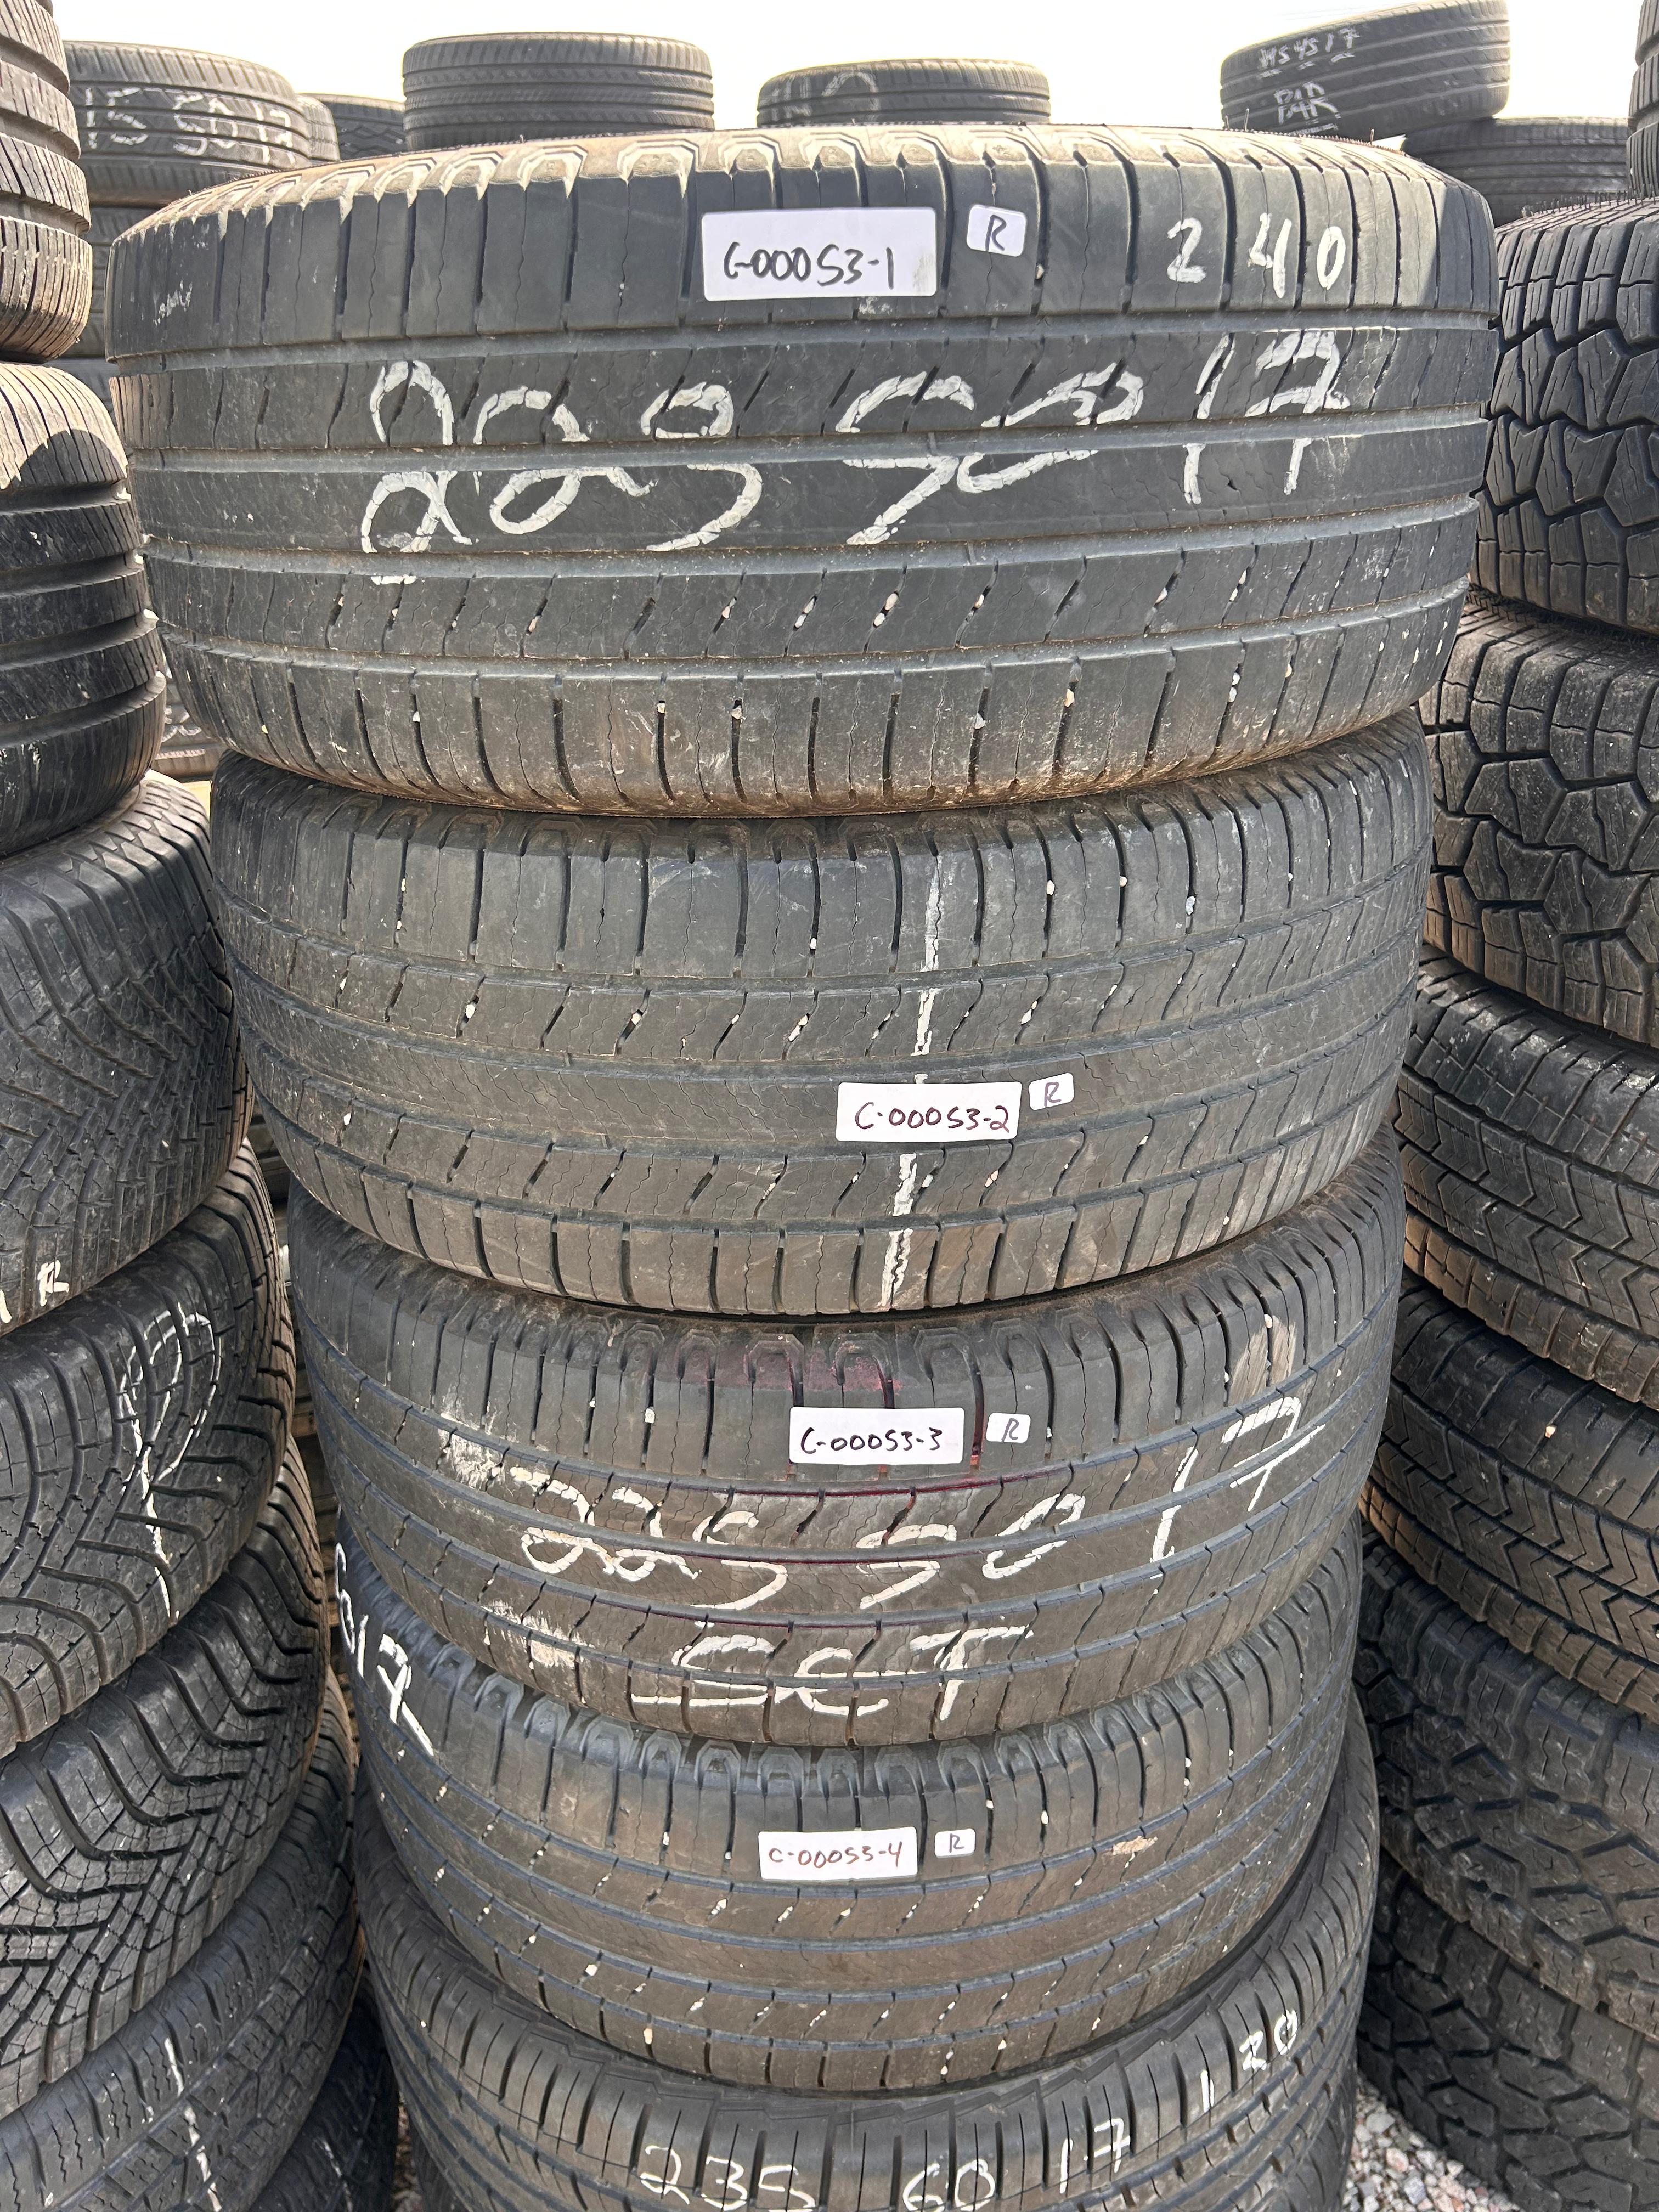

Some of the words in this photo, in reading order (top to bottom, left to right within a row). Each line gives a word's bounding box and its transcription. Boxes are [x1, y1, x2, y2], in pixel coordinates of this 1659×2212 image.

[984, 214, 1007, 254] R
[1167, 212, 1346, 298] 240
[1183, 329, 1351, 504] 17
[1044, 1081, 1062, 1107] R
[1001, 1417, 1019, 1442] R
[1150, 1396, 1325, 1570] 17
[949, 1833, 964, 1853] R
[640, 2145, 816, 2212] 235
[902, 2159, 996, 2212] 60
[1059, 2117, 1131, 2194] 17
